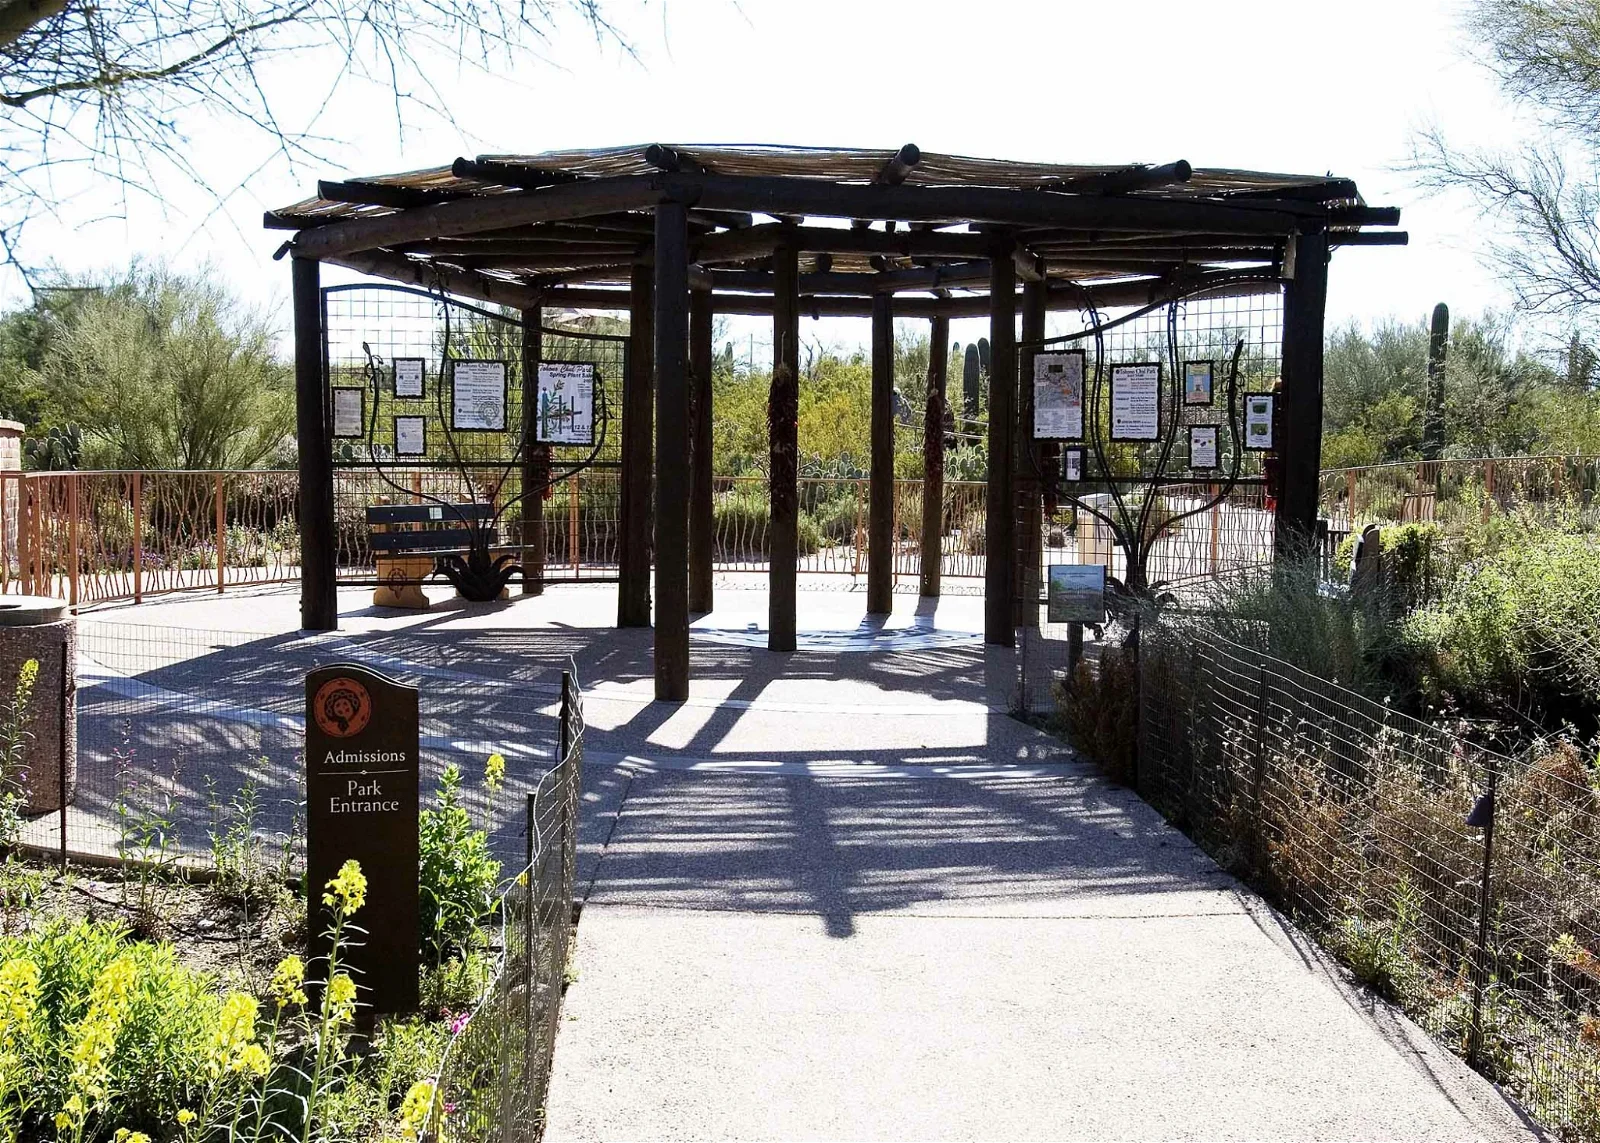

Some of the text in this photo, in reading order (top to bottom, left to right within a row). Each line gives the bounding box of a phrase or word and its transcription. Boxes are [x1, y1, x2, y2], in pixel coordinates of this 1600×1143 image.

[560, 364, 575, 373] Chul
[324, 749, 406, 764] Admissions
[347, 780, 382, 796] Park
[330, 797, 400, 813] Entrance
